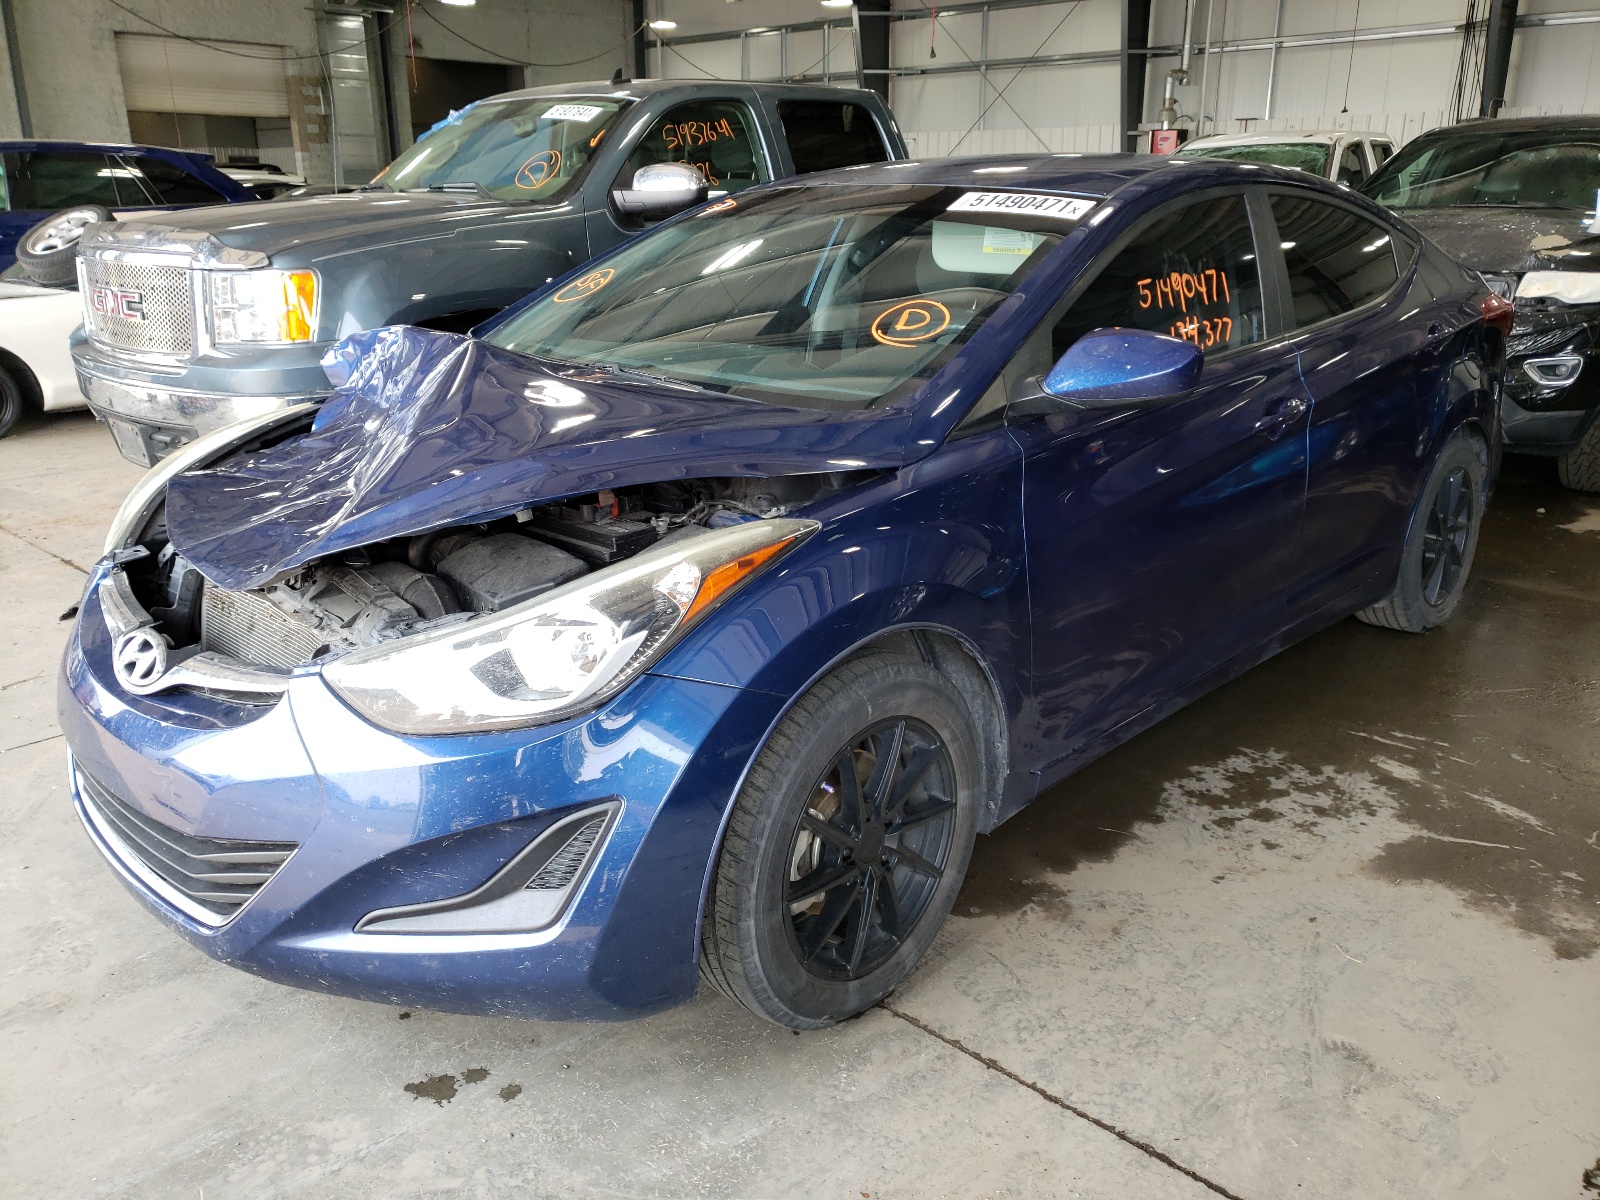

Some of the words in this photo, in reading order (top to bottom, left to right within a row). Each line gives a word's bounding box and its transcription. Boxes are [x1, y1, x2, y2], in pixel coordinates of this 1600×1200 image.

[662, 118, 735, 149] 51937641
[92, 286, 143, 320] GMC
[1137, 268, 1230, 313] 51490471
